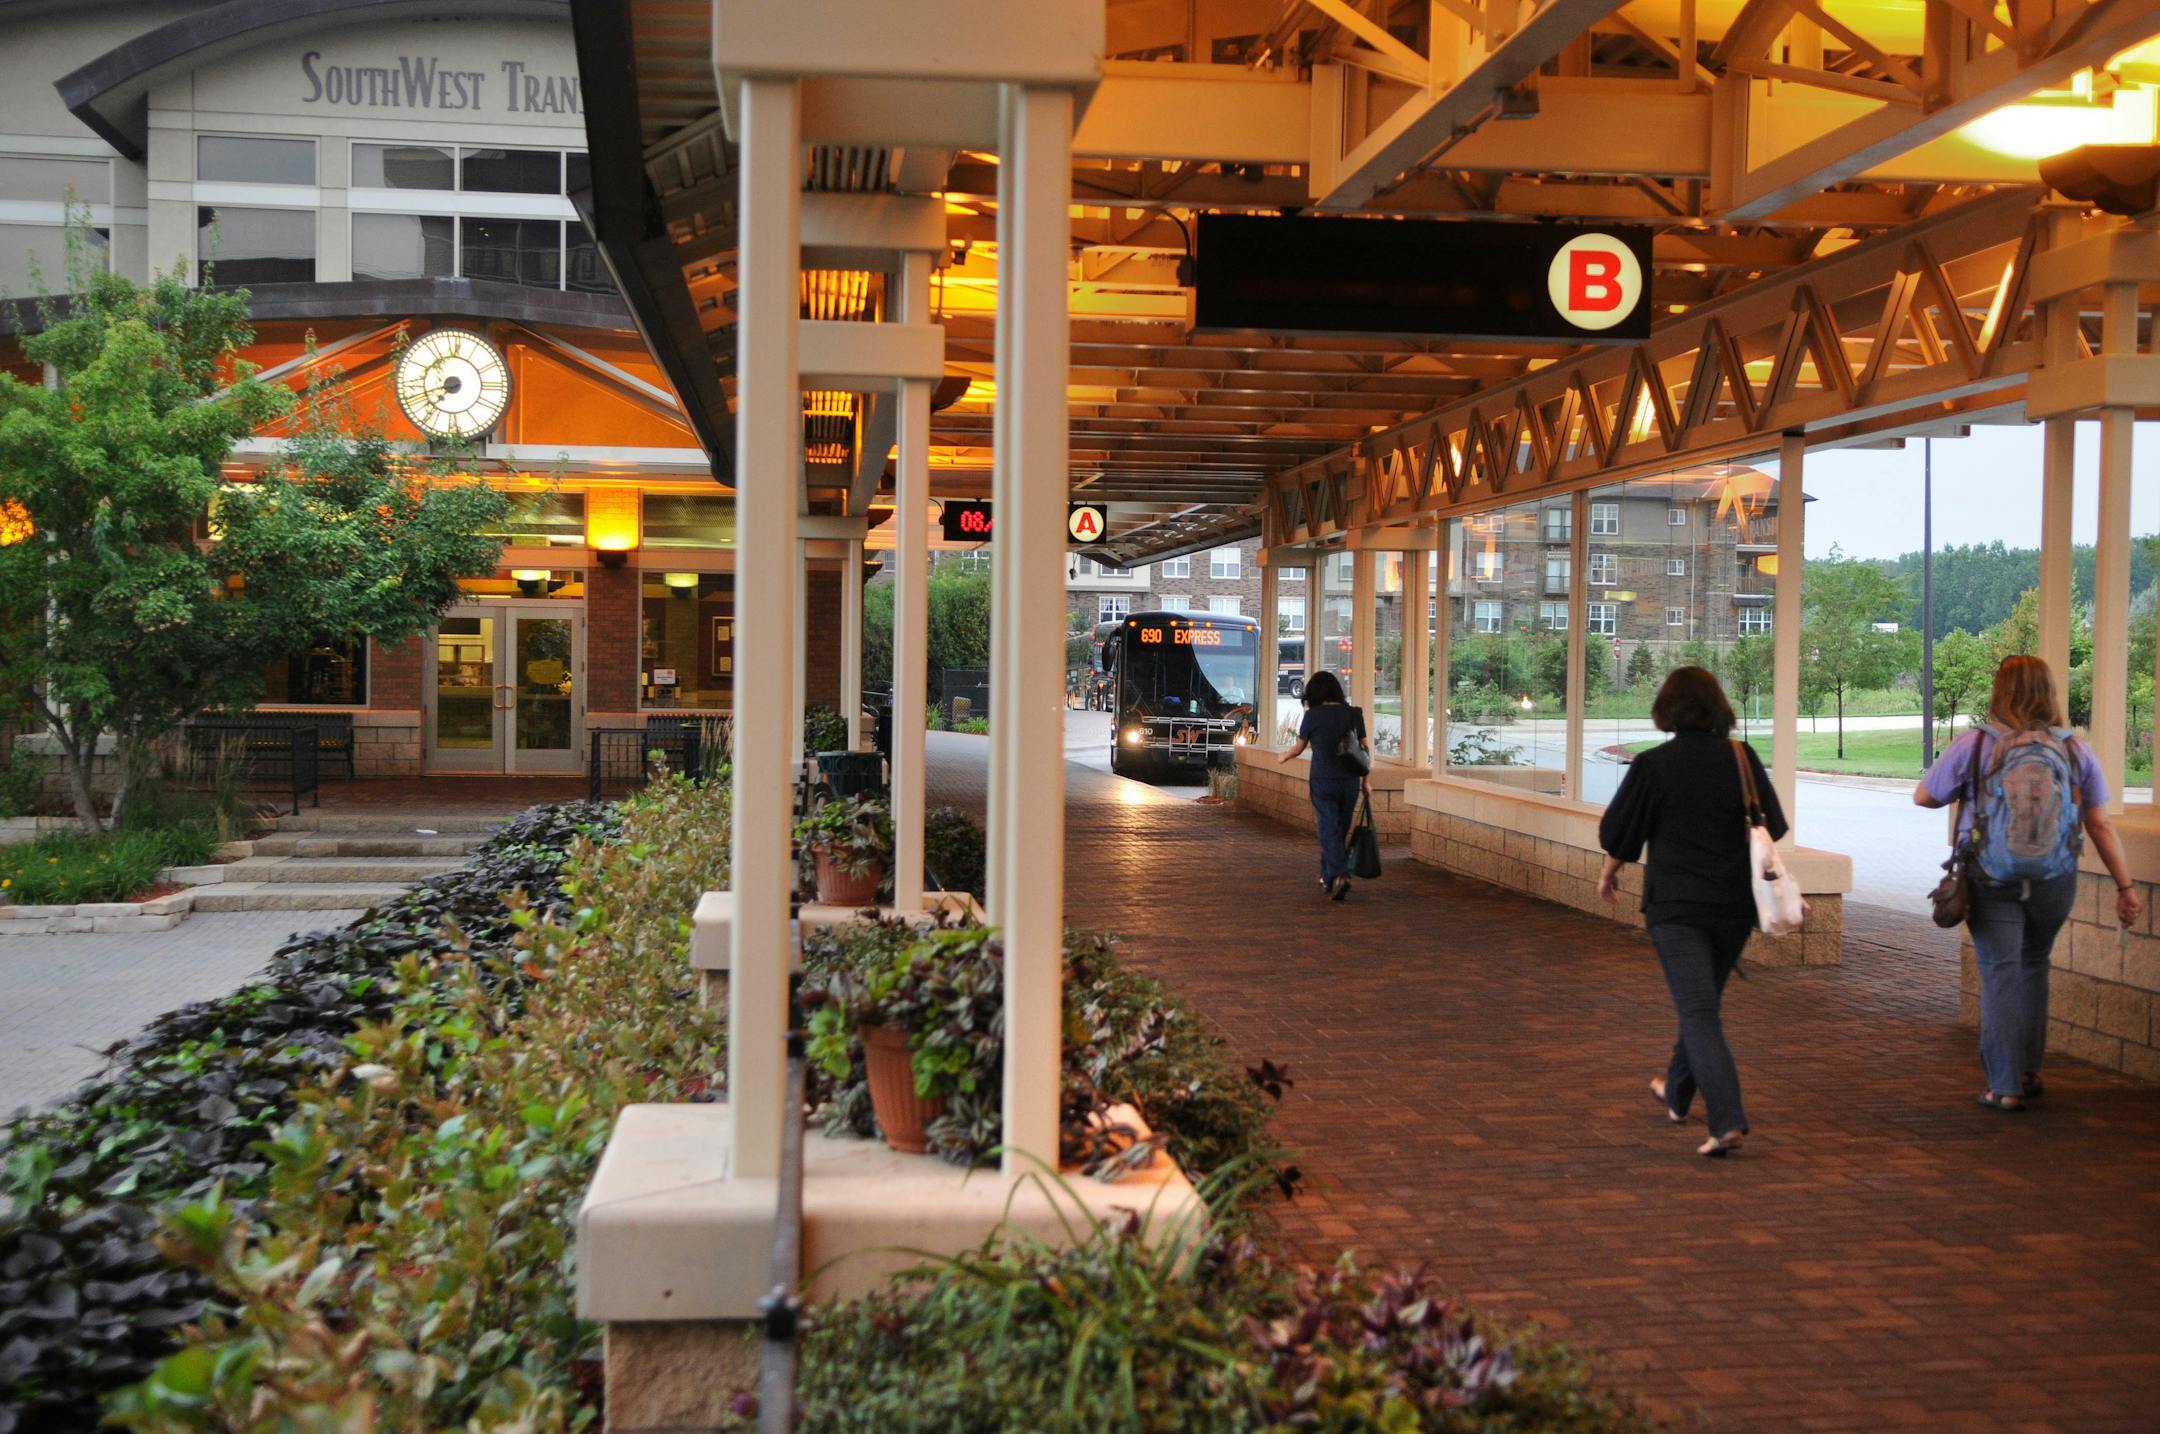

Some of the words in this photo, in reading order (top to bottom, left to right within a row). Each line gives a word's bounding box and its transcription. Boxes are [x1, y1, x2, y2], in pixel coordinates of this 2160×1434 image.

[1568, 250, 1623, 312] B
[1076, 512, 1097, 533] A
[1141, 628, 1162, 643] 690
[1174, 629, 1220, 645] EXPRESS
